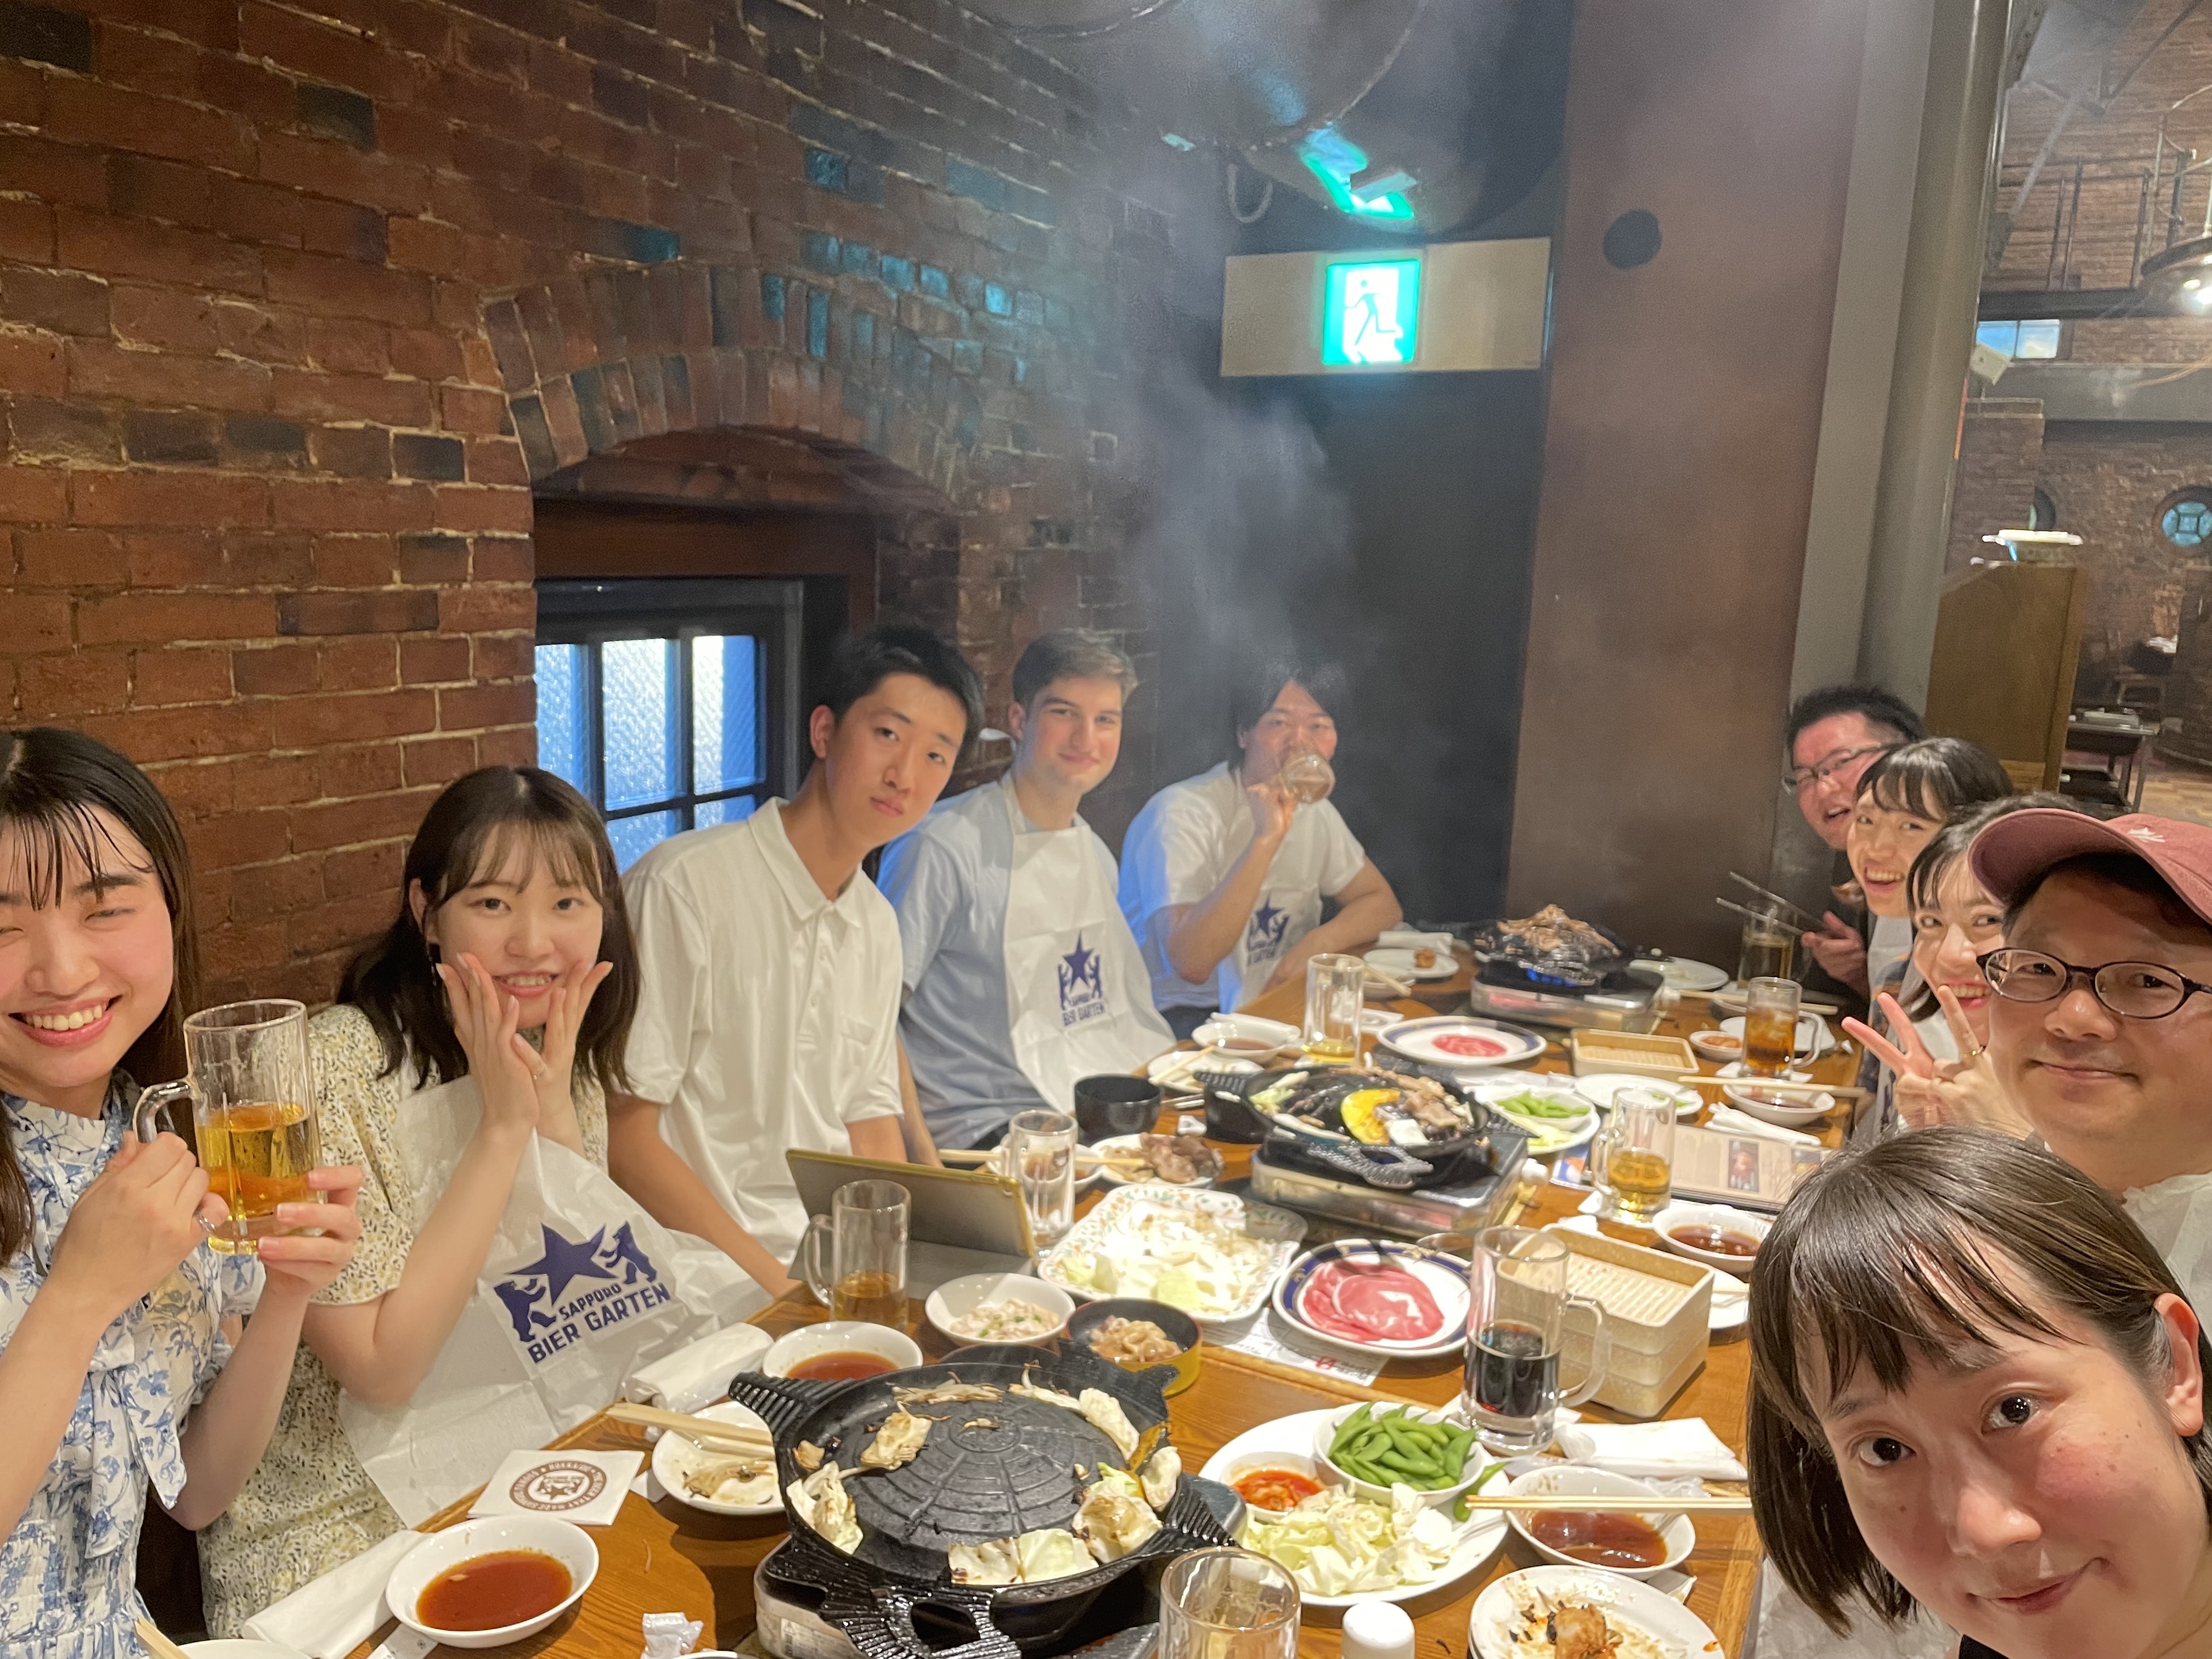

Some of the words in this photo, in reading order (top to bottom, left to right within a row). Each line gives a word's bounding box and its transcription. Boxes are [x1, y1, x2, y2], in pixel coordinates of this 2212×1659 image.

[528, 1323, 581, 1363] BIER
[585, 1282, 671, 1331] GARTEN
[560, 1283, 622, 1320] SAPPORO
